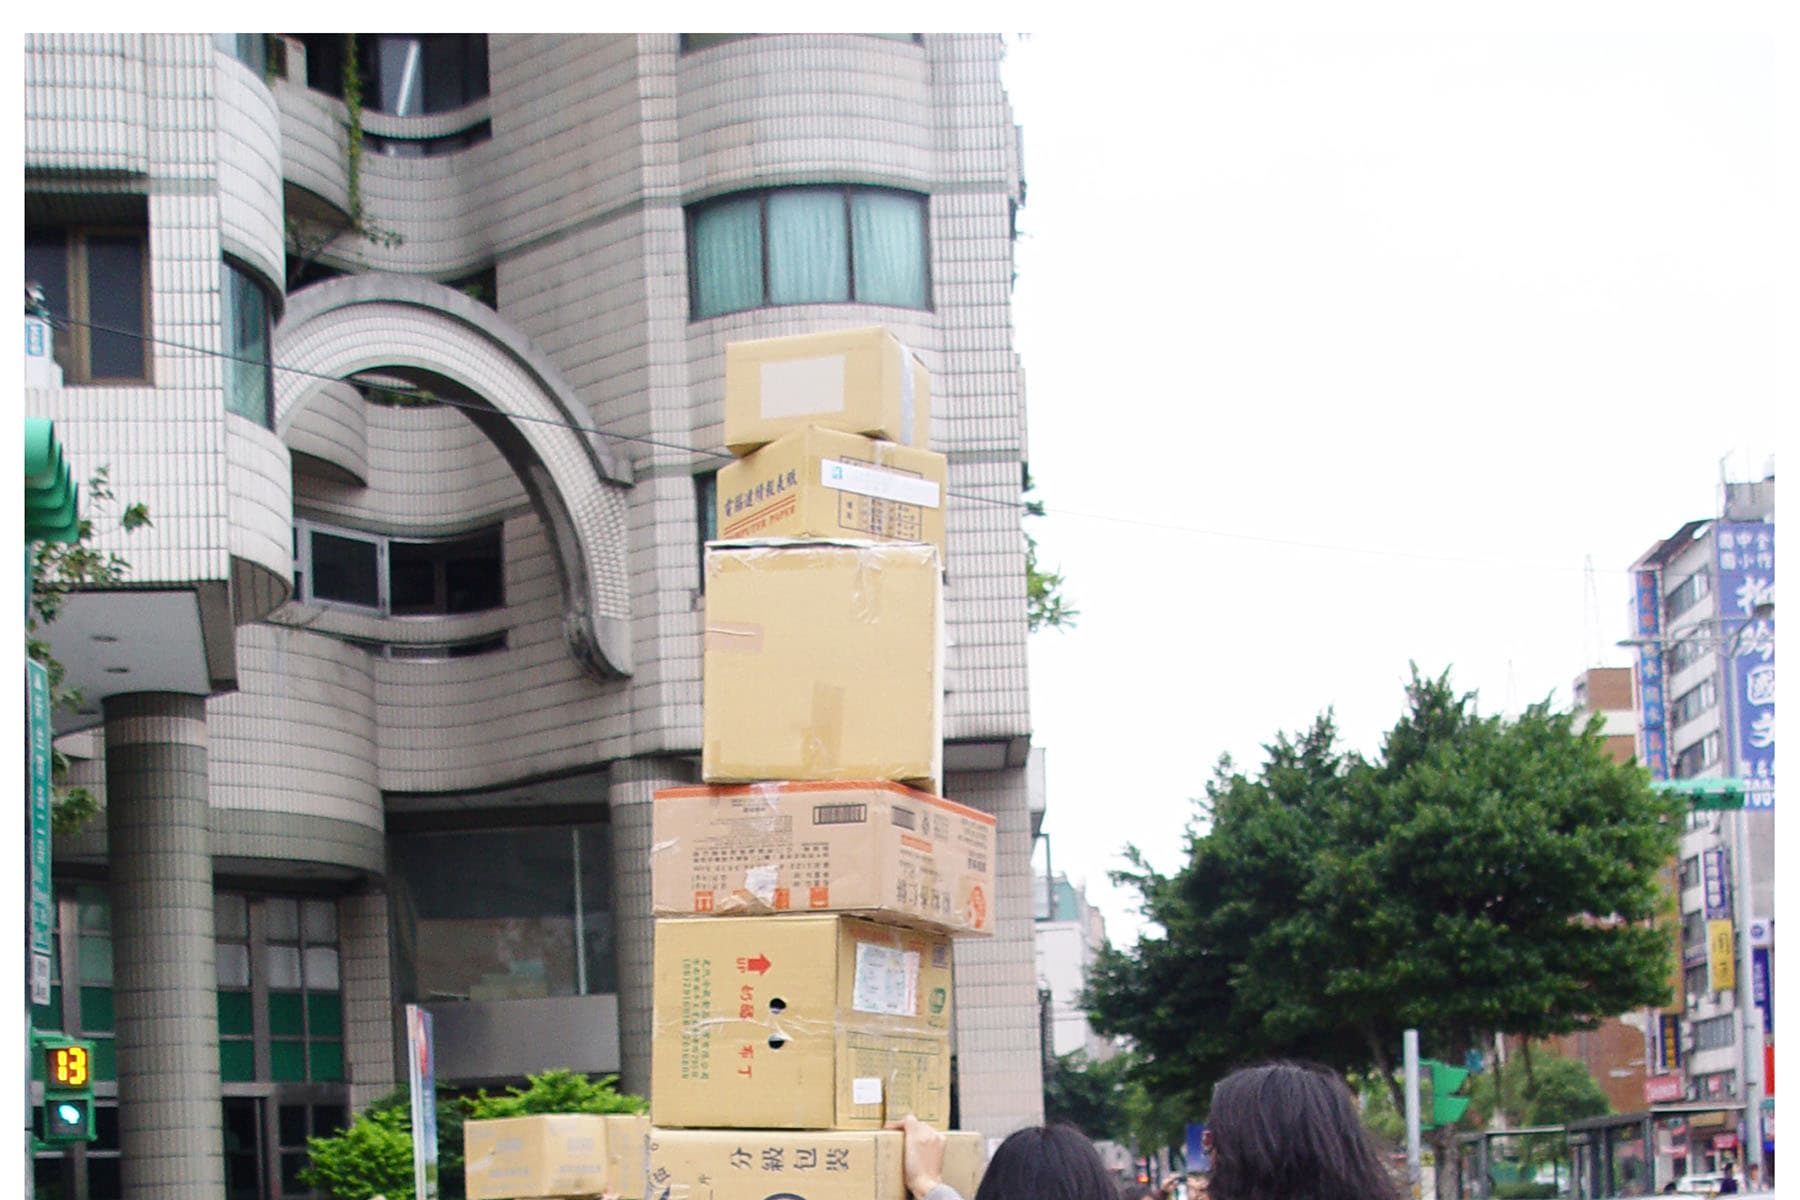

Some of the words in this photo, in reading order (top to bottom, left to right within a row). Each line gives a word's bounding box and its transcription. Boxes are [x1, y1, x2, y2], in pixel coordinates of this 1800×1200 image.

[736, 957, 746, 974] UP
[57, 1047, 86, 1086] 13
[731, 1147, 850, 1172] 分級包裝
